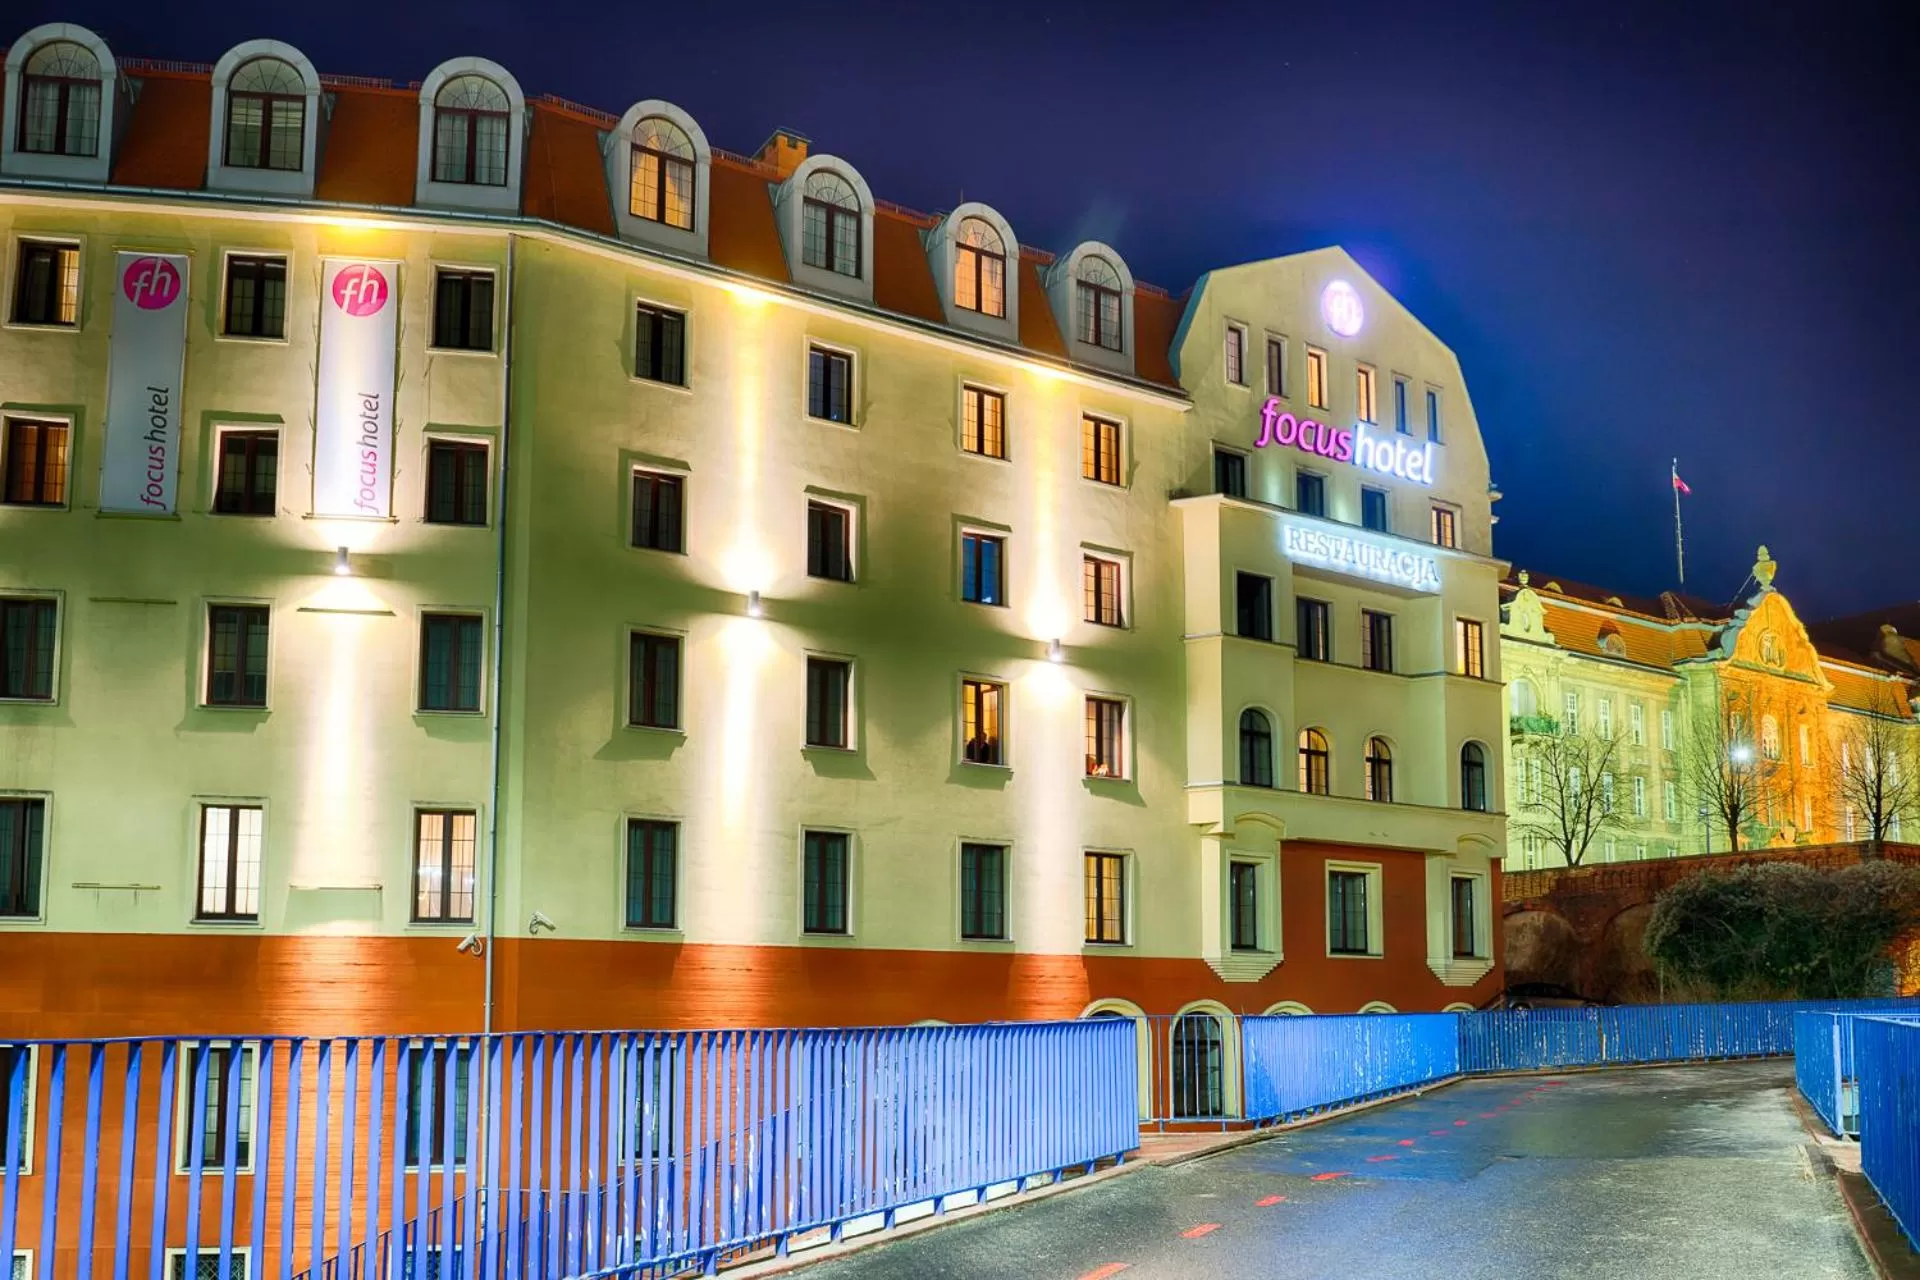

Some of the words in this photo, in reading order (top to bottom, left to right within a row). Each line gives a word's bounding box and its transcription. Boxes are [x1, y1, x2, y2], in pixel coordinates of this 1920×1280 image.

[131, 256, 172, 305] fh
[340, 264, 380, 314] fh
[1287, 526, 1441, 584] RESTAURACJA
